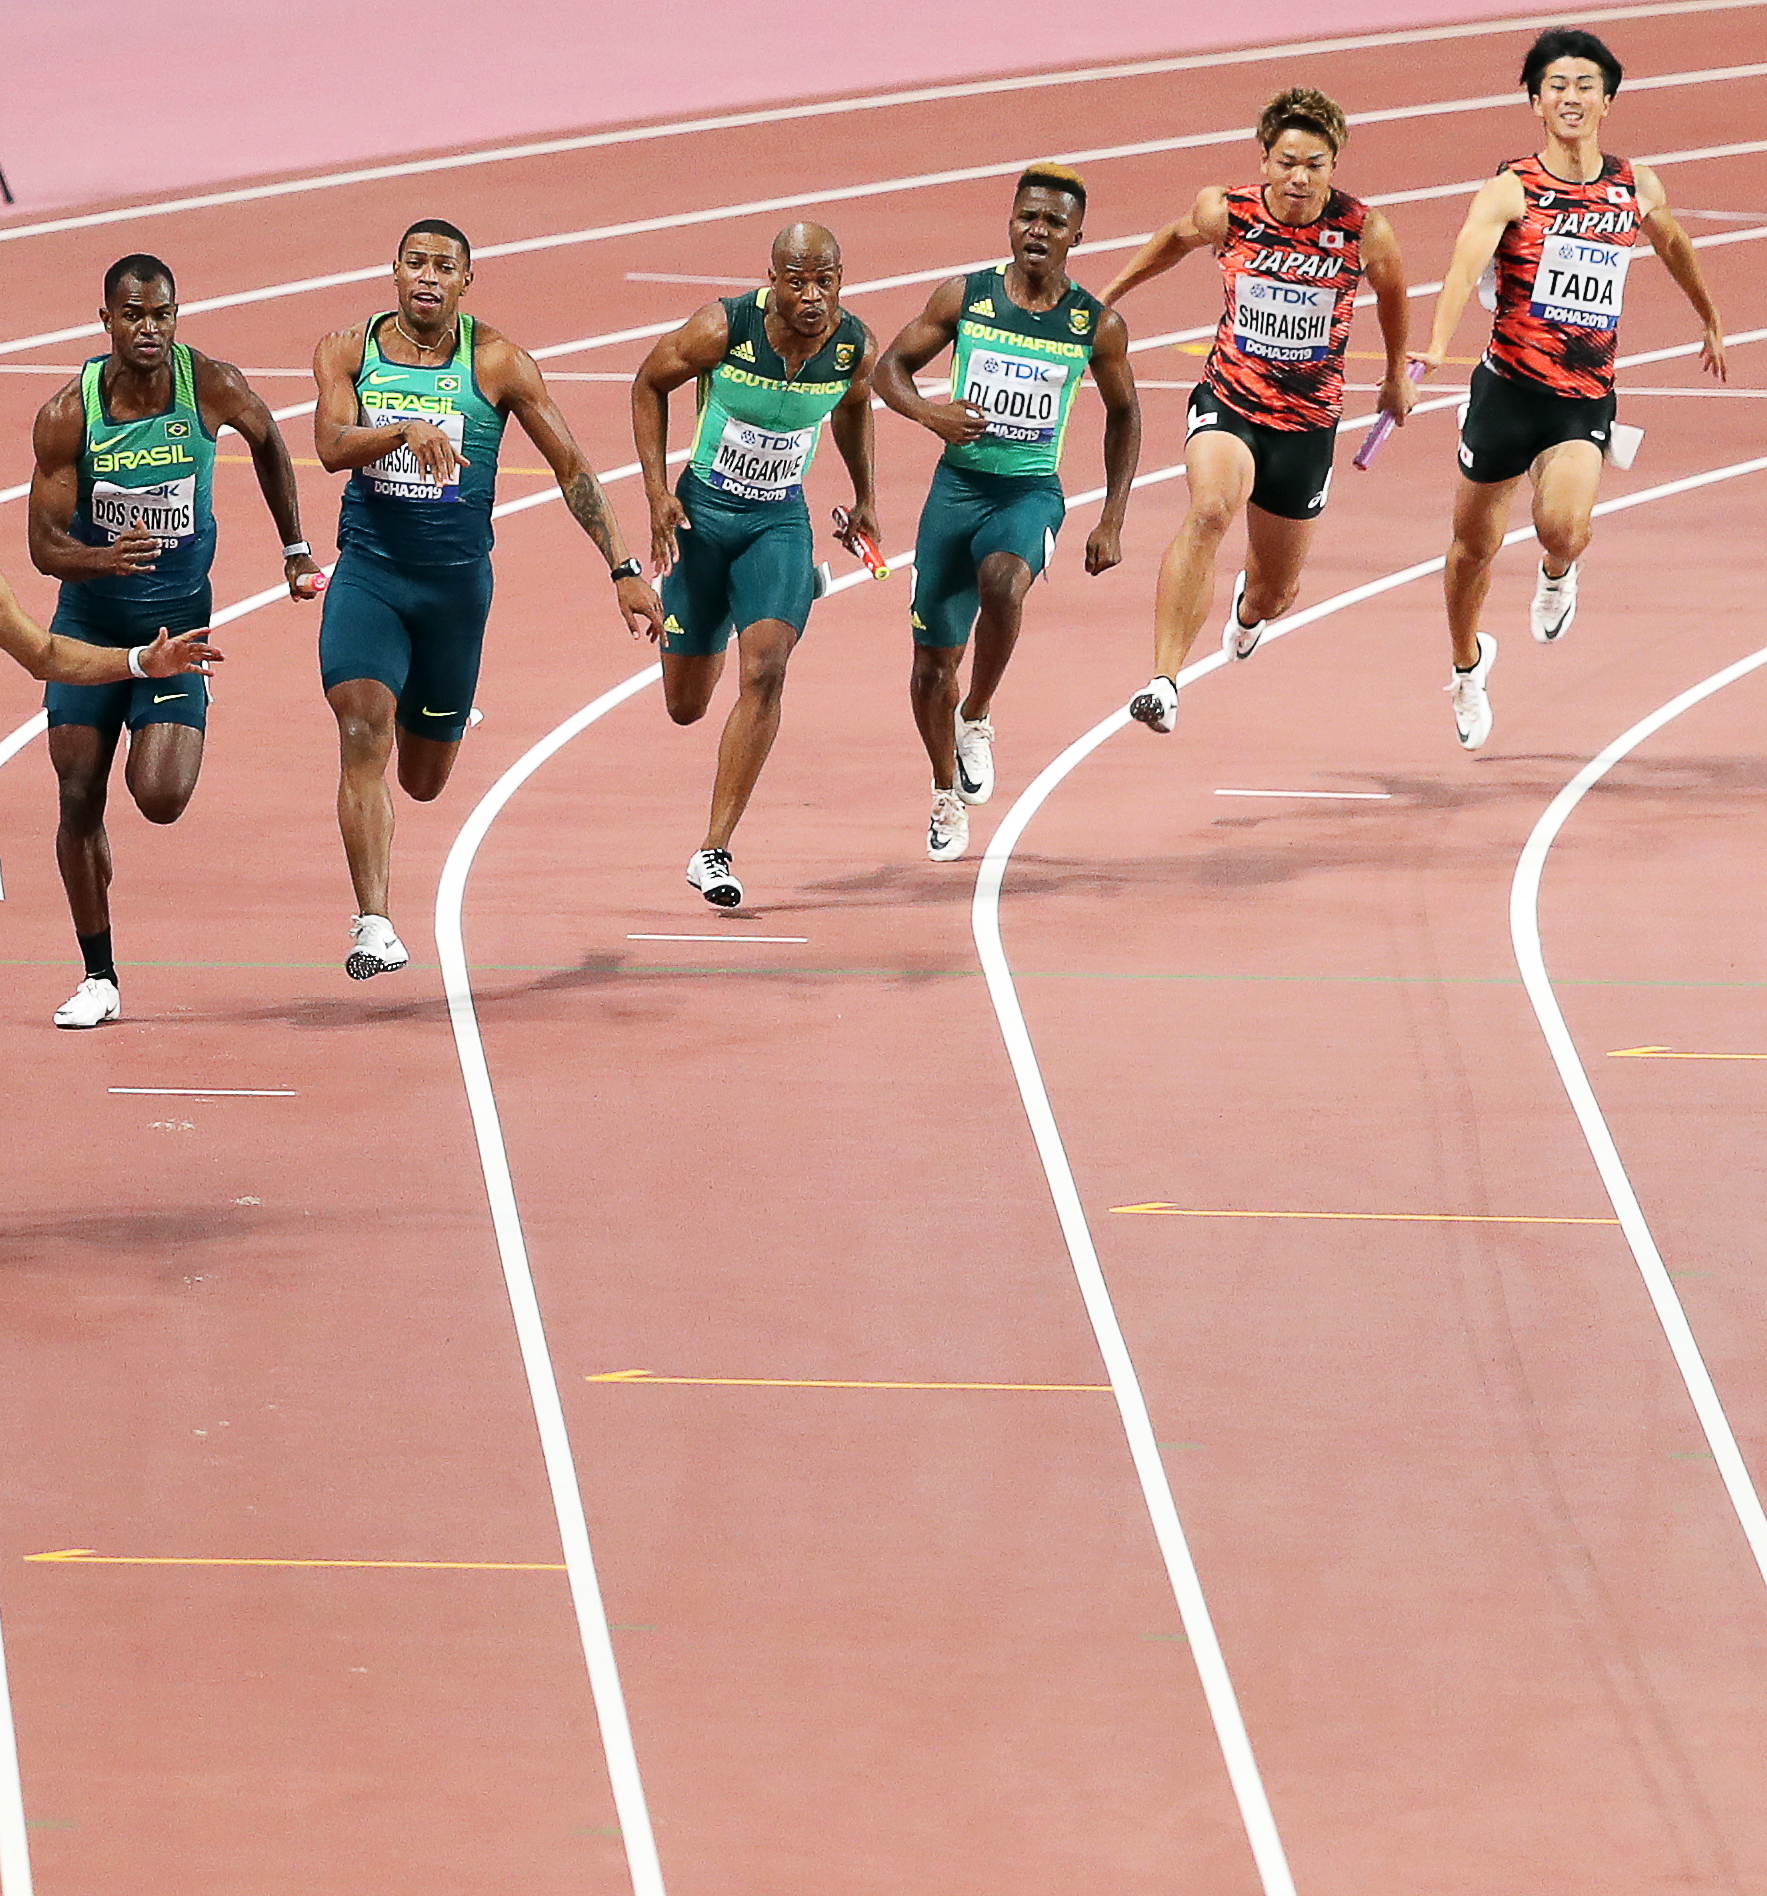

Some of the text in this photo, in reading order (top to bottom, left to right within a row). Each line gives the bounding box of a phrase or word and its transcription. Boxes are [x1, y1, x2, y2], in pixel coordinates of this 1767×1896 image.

[1542, 211, 1634, 235] JAPAN
[1244, 249, 1343, 278] JAPAN
[1575, 246, 1620, 267] TDK
[1267, 285, 1320, 307] TDK
[1548, 269, 1613, 305] TADA
[1239, 304, 1326, 340] SHIRAISHI
[1543, 306, 1609, 328] DOHA2019
[1245, 339, 1312, 360] DOHA2019
[1001, 361, 1051, 382] TDK
[362, 391, 463, 415] BRASIL
[968, 381, 1052, 420] DLODLO
[757, 434, 801, 450] TDK
[986, 423, 1040, 441] HA2019
[94, 444, 194, 472] BRASIL
[719, 445, 802, 482] MAGAKWE
[144, 484, 180, 499] DK
[374, 481, 443, 499] DOHA2019
[722, 478, 787, 501] DOHA2019
[95, 499, 190, 531] DOS SANTOS
